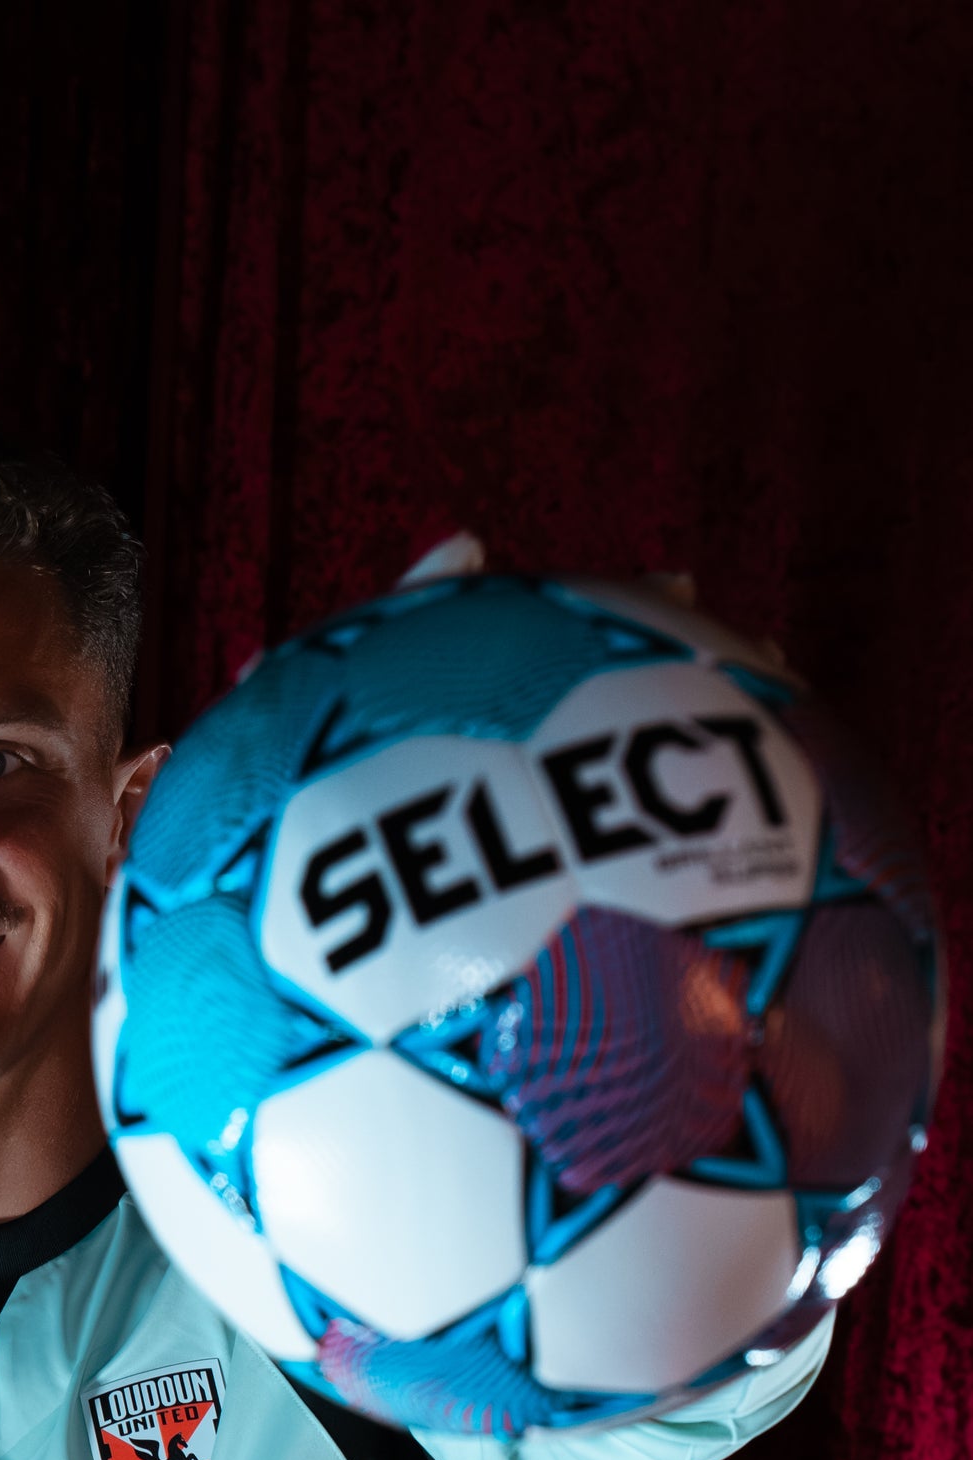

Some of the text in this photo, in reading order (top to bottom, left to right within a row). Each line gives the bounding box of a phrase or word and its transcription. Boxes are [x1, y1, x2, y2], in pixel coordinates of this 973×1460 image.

[299, 717, 789, 973] SELECT
[94, 1371, 214, 1428] LOUDOUN
[118, 1405, 200, 1437] UNITED
